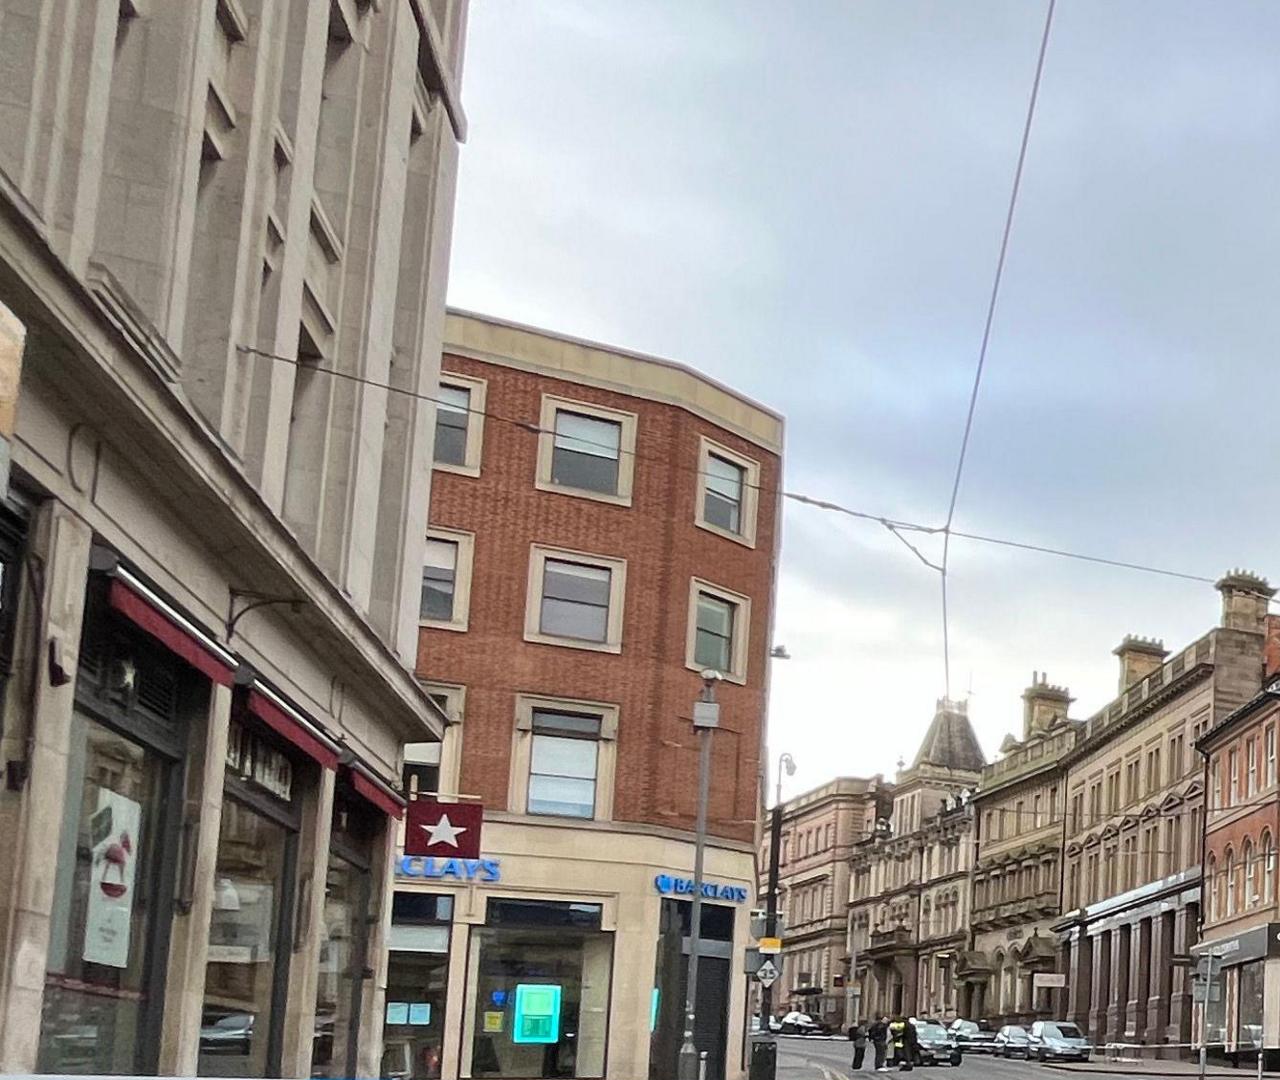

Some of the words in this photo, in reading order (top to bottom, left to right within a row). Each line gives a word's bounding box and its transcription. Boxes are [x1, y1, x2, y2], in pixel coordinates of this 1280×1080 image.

[396, 856, 501, 882] CLAYS
[674, 879, 748, 903] BACLAYS
[759, 968, 778, 980] 35
